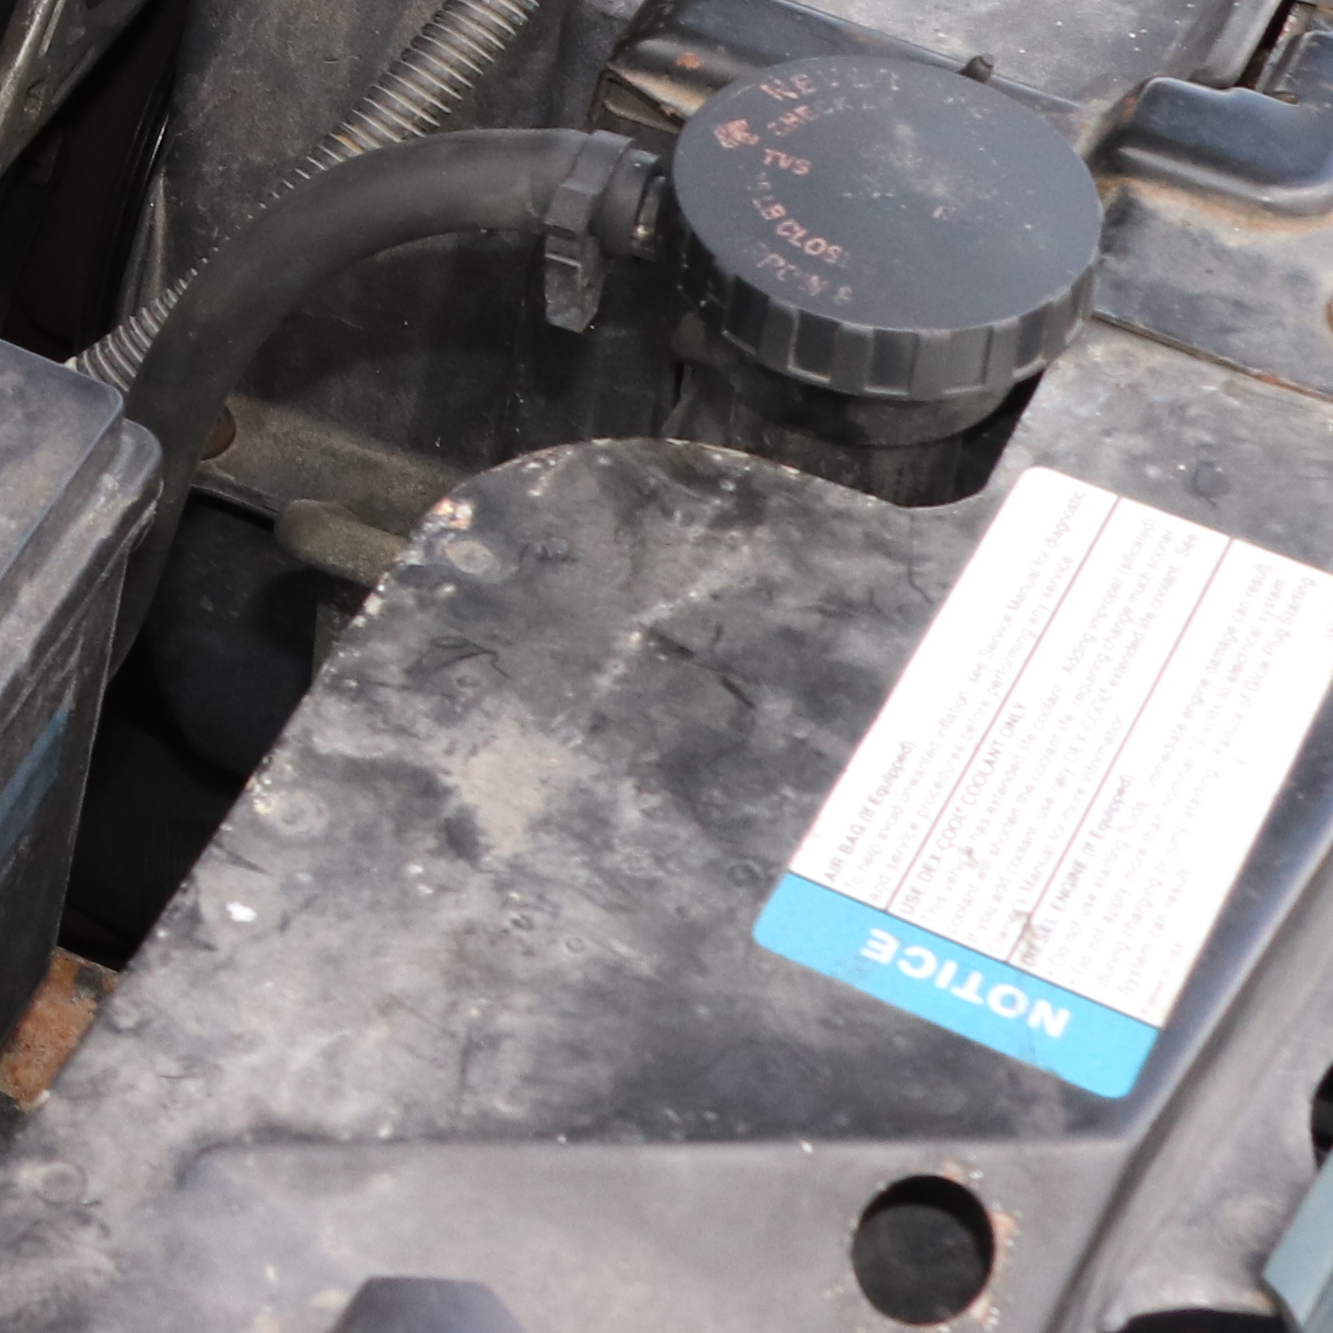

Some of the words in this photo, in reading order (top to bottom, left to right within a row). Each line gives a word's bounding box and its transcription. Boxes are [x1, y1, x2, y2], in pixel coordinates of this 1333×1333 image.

[821, 855, 846, 883] AIR
[836, 822, 867, 856] BAG
[865, 739, 917, 807] Equipped)
[897, 884, 925, 915] USE
[958, 738, 1005, 807] COOLANT
[998, 701, 1028, 737] ONLY
[1049, 857, 1088, 912] ENGINE
[1087, 773, 1136, 841] Equipped)
[860, 928, 1071, 1039] NOTICE
